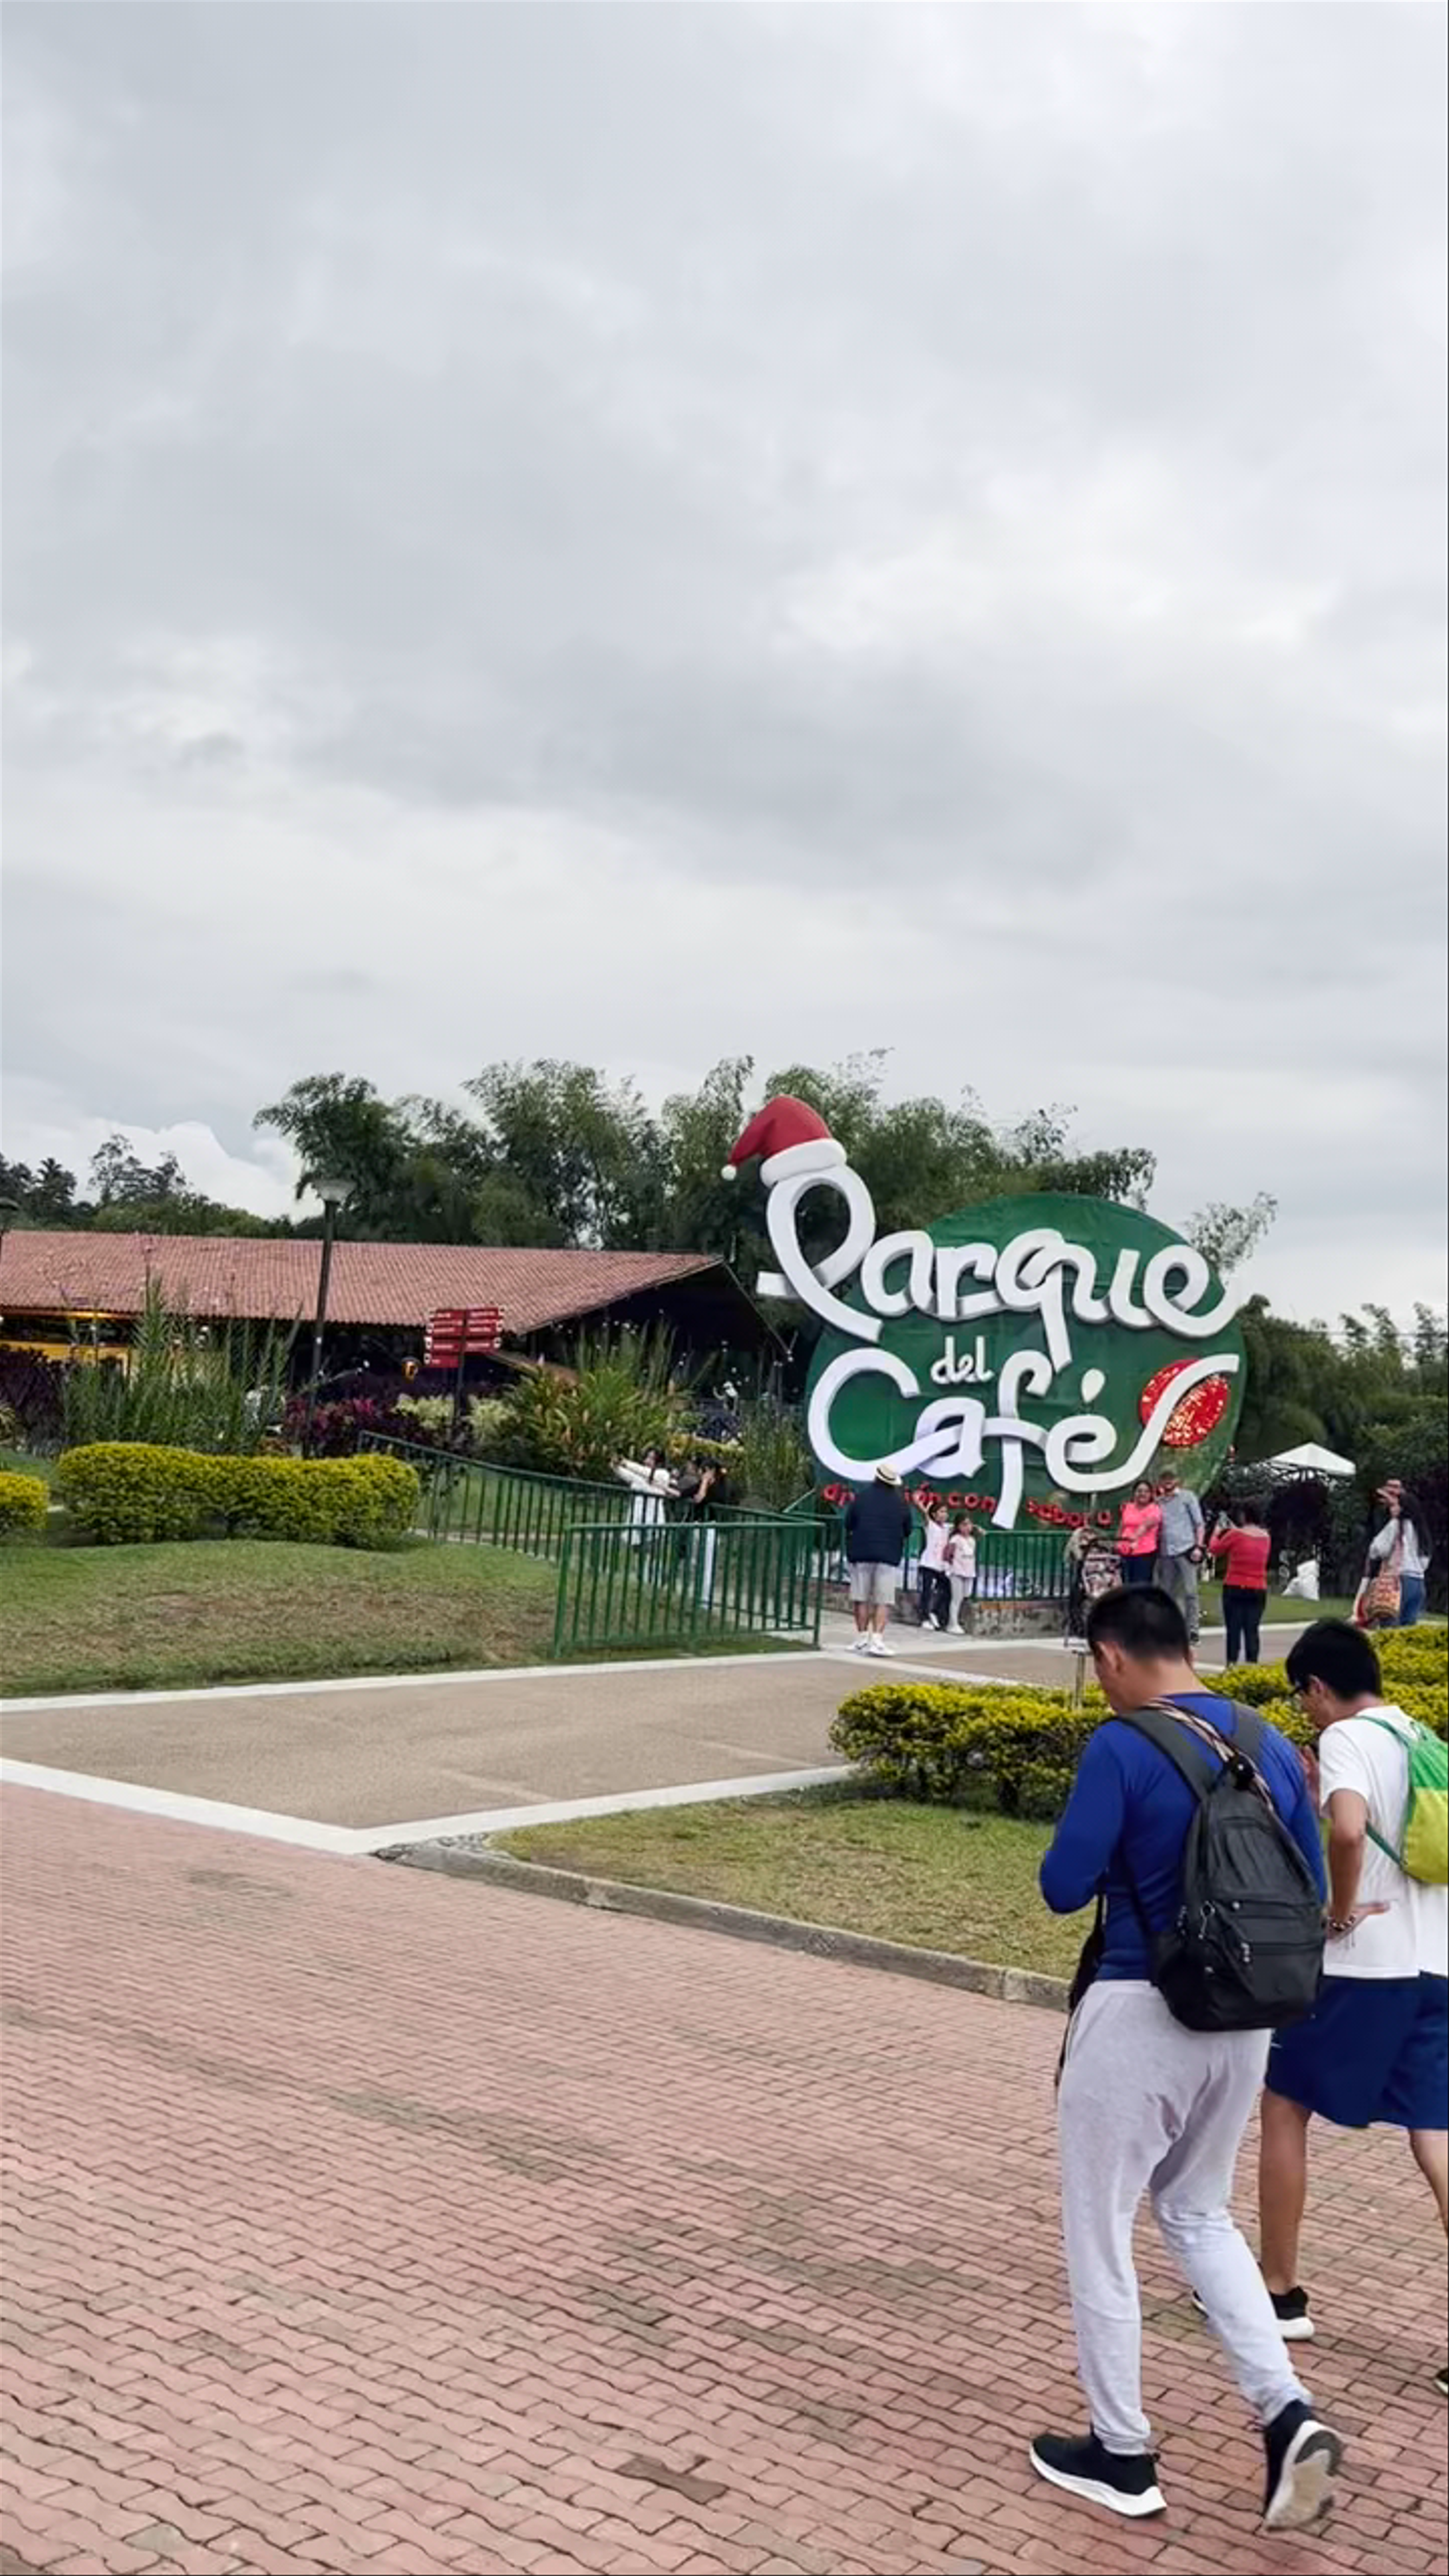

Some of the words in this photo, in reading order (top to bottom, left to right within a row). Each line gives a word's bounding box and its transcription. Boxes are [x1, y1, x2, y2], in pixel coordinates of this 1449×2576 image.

[757, 1165, 1241, 1373] Parque
[930, 1336, 994, 1385] del
[809, 1349, 1239, 1529] Café
[948, 1492, 997, 1513] con
[1098, 1510, 1111, 1525] a
